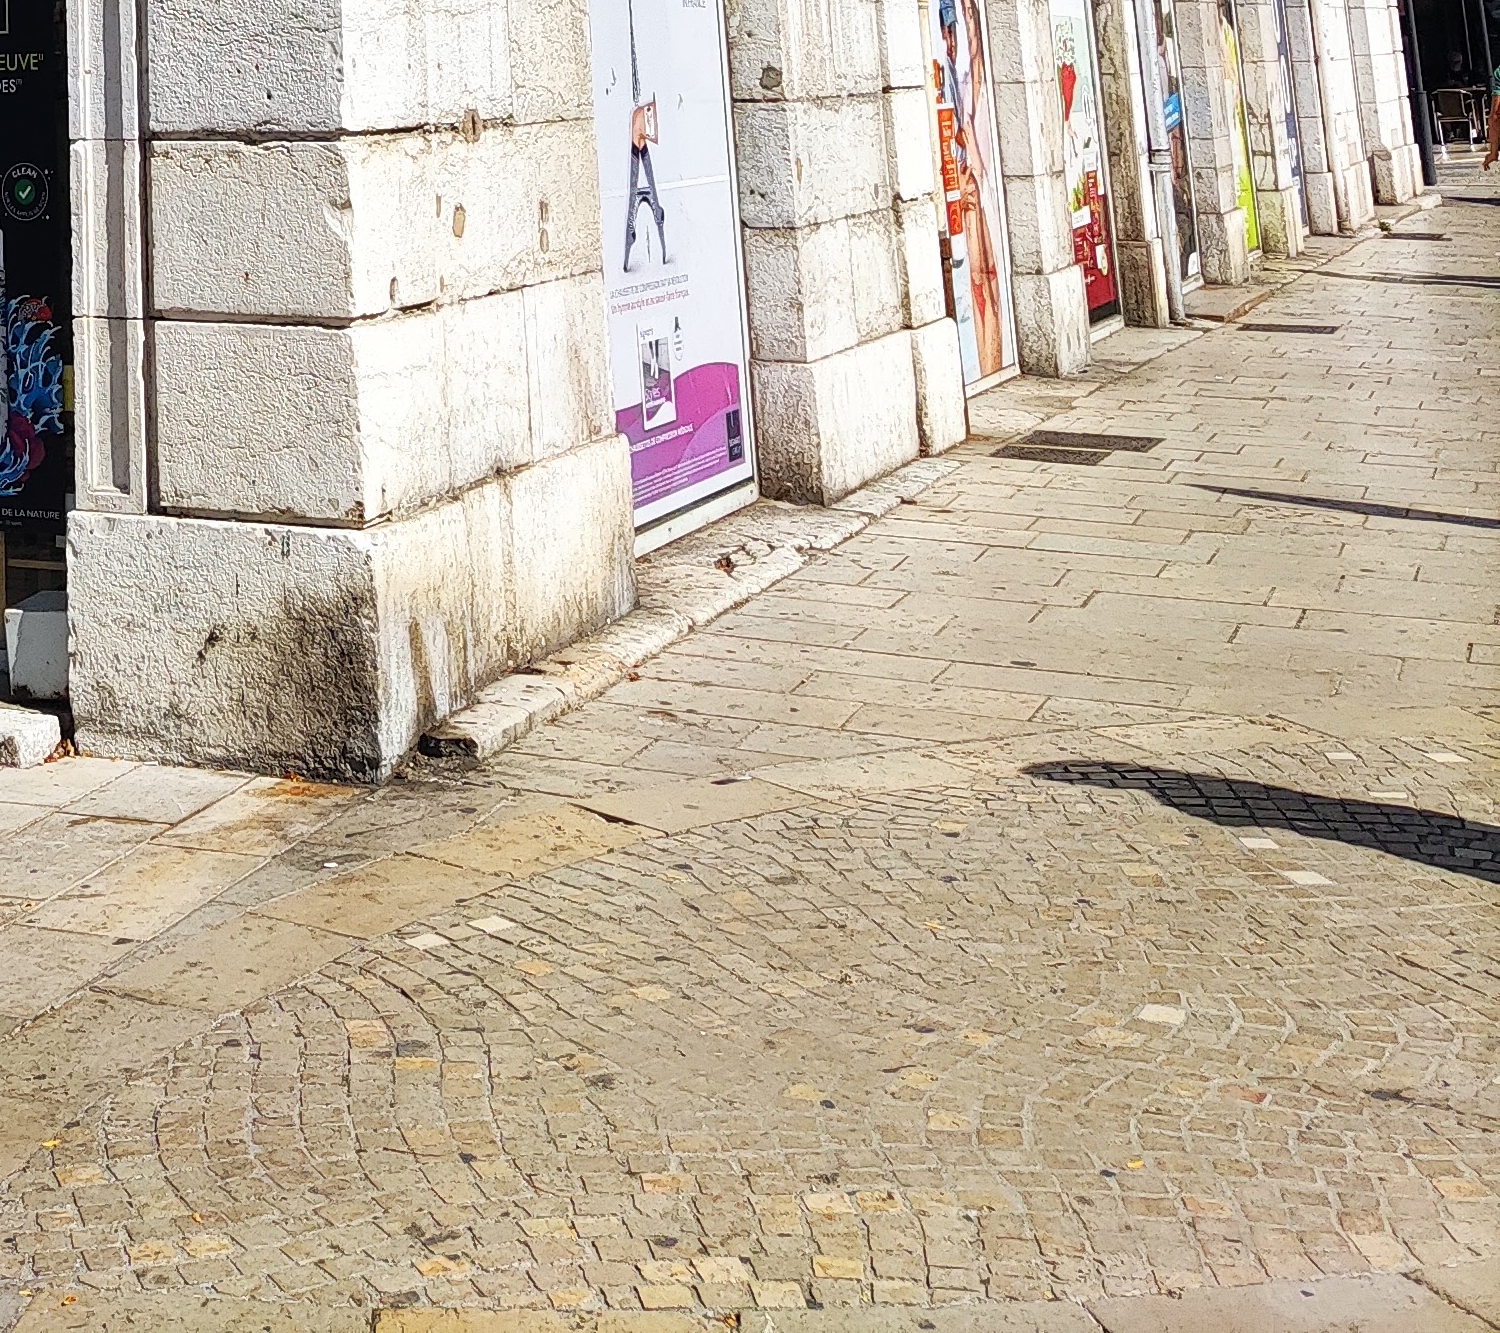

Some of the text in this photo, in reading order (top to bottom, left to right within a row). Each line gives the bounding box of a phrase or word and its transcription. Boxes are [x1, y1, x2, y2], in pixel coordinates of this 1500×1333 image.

[12, 167, 38, 179] CLEAN
[2, 508, 13, 517] DE
[14, 509, 25, 517] LA
[27, 509, 60, 520] NATURE
